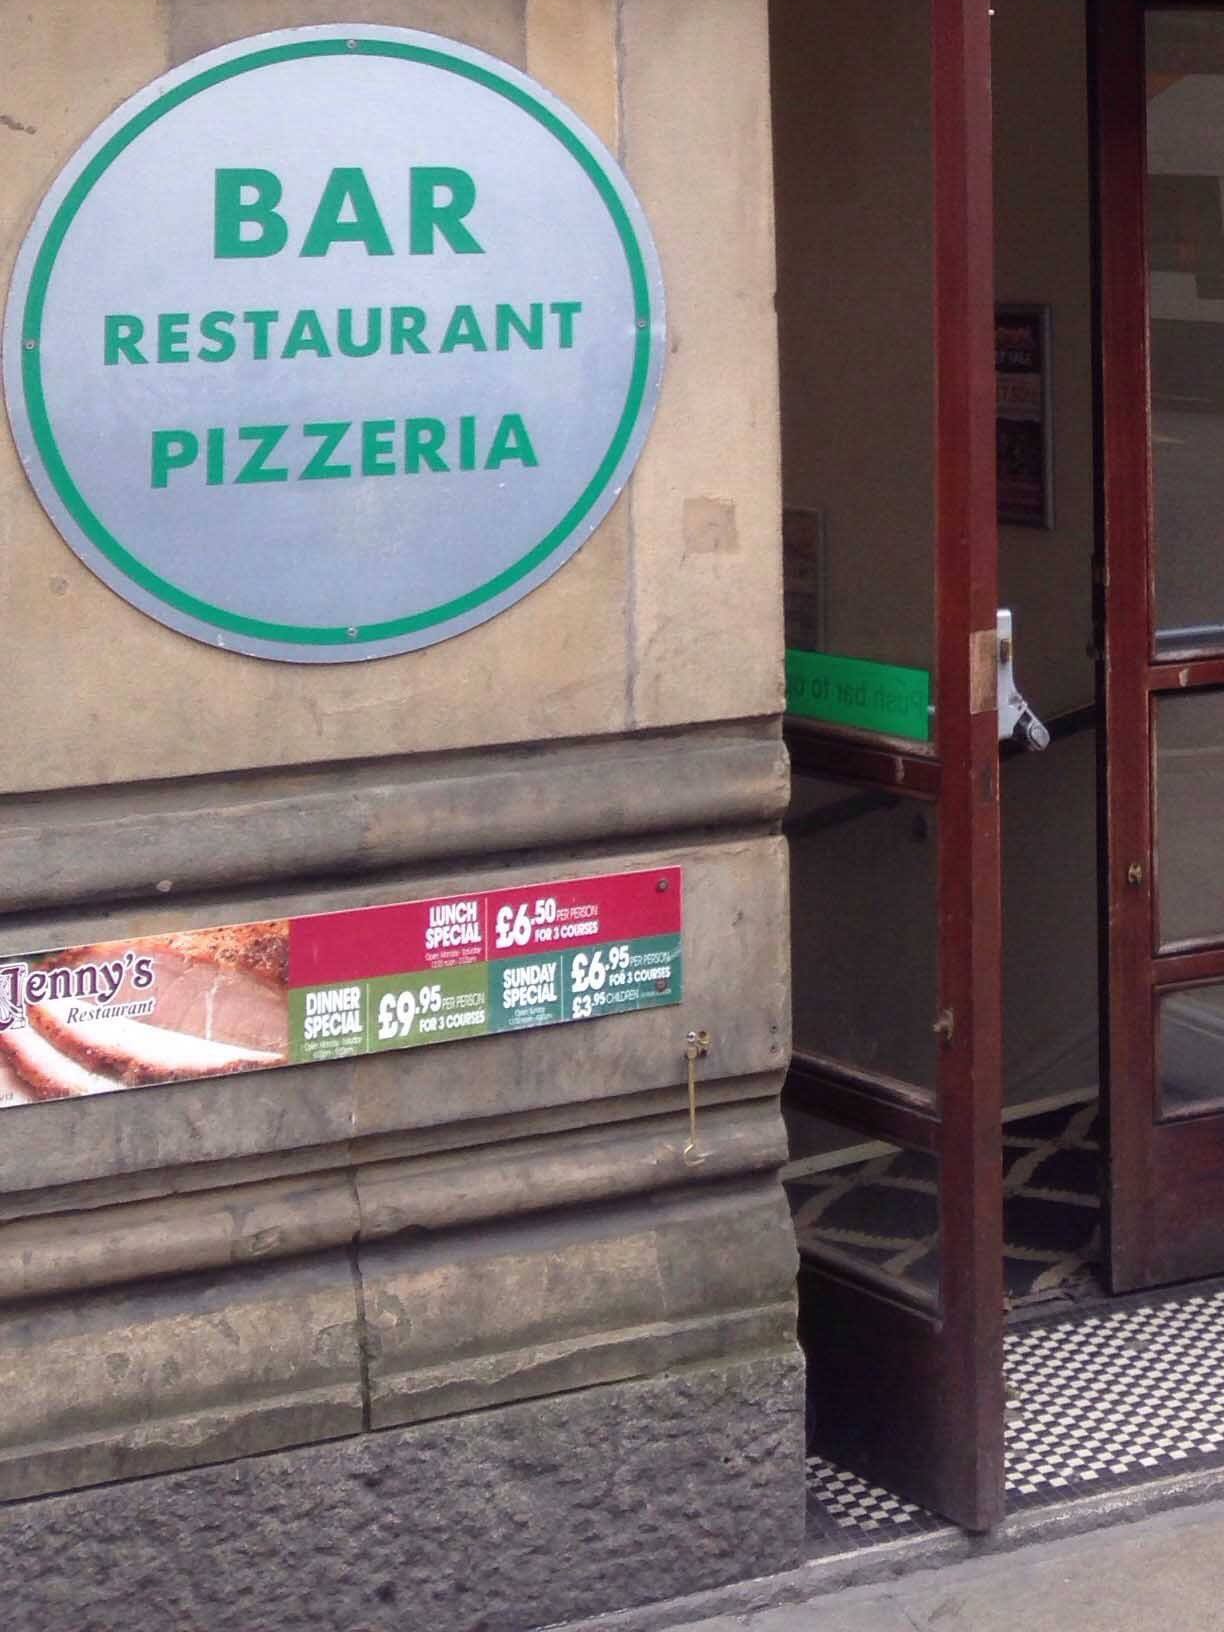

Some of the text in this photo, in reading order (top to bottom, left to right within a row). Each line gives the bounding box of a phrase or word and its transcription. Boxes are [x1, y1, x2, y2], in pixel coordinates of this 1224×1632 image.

[213, 167, 485, 259] BAR
[104, 301, 582, 366] RESTAURANT
[151, 414, 539, 489] PIZZERIA
[429, 901, 478, 928] LUNCH
[496, 898, 598, 949] £6.50 PER PERSON
[425, 922, 482, 950] SPECIAL
[535, 921, 598, 942] FOR 3 COURSES
[503, 962, 557, 989] SUNDAY
[571, 945, 630, 992] £6.95
[609, 966, 671, 986] FOR 3 COURSES
[306, 986, 361, 1016] DINNER
[503, 982, 558, 1009] SPECIAL
[572, 991, 606, 1018] £3.95
[67, 1000, 153, 1024] Restaurant
[304, 1010, 362, 1040] SPECIAL
[378, 985, 485, 1040] £9.95 PER PERSON
[419, 1009, 486, 1033] FOR 3 COURSES
